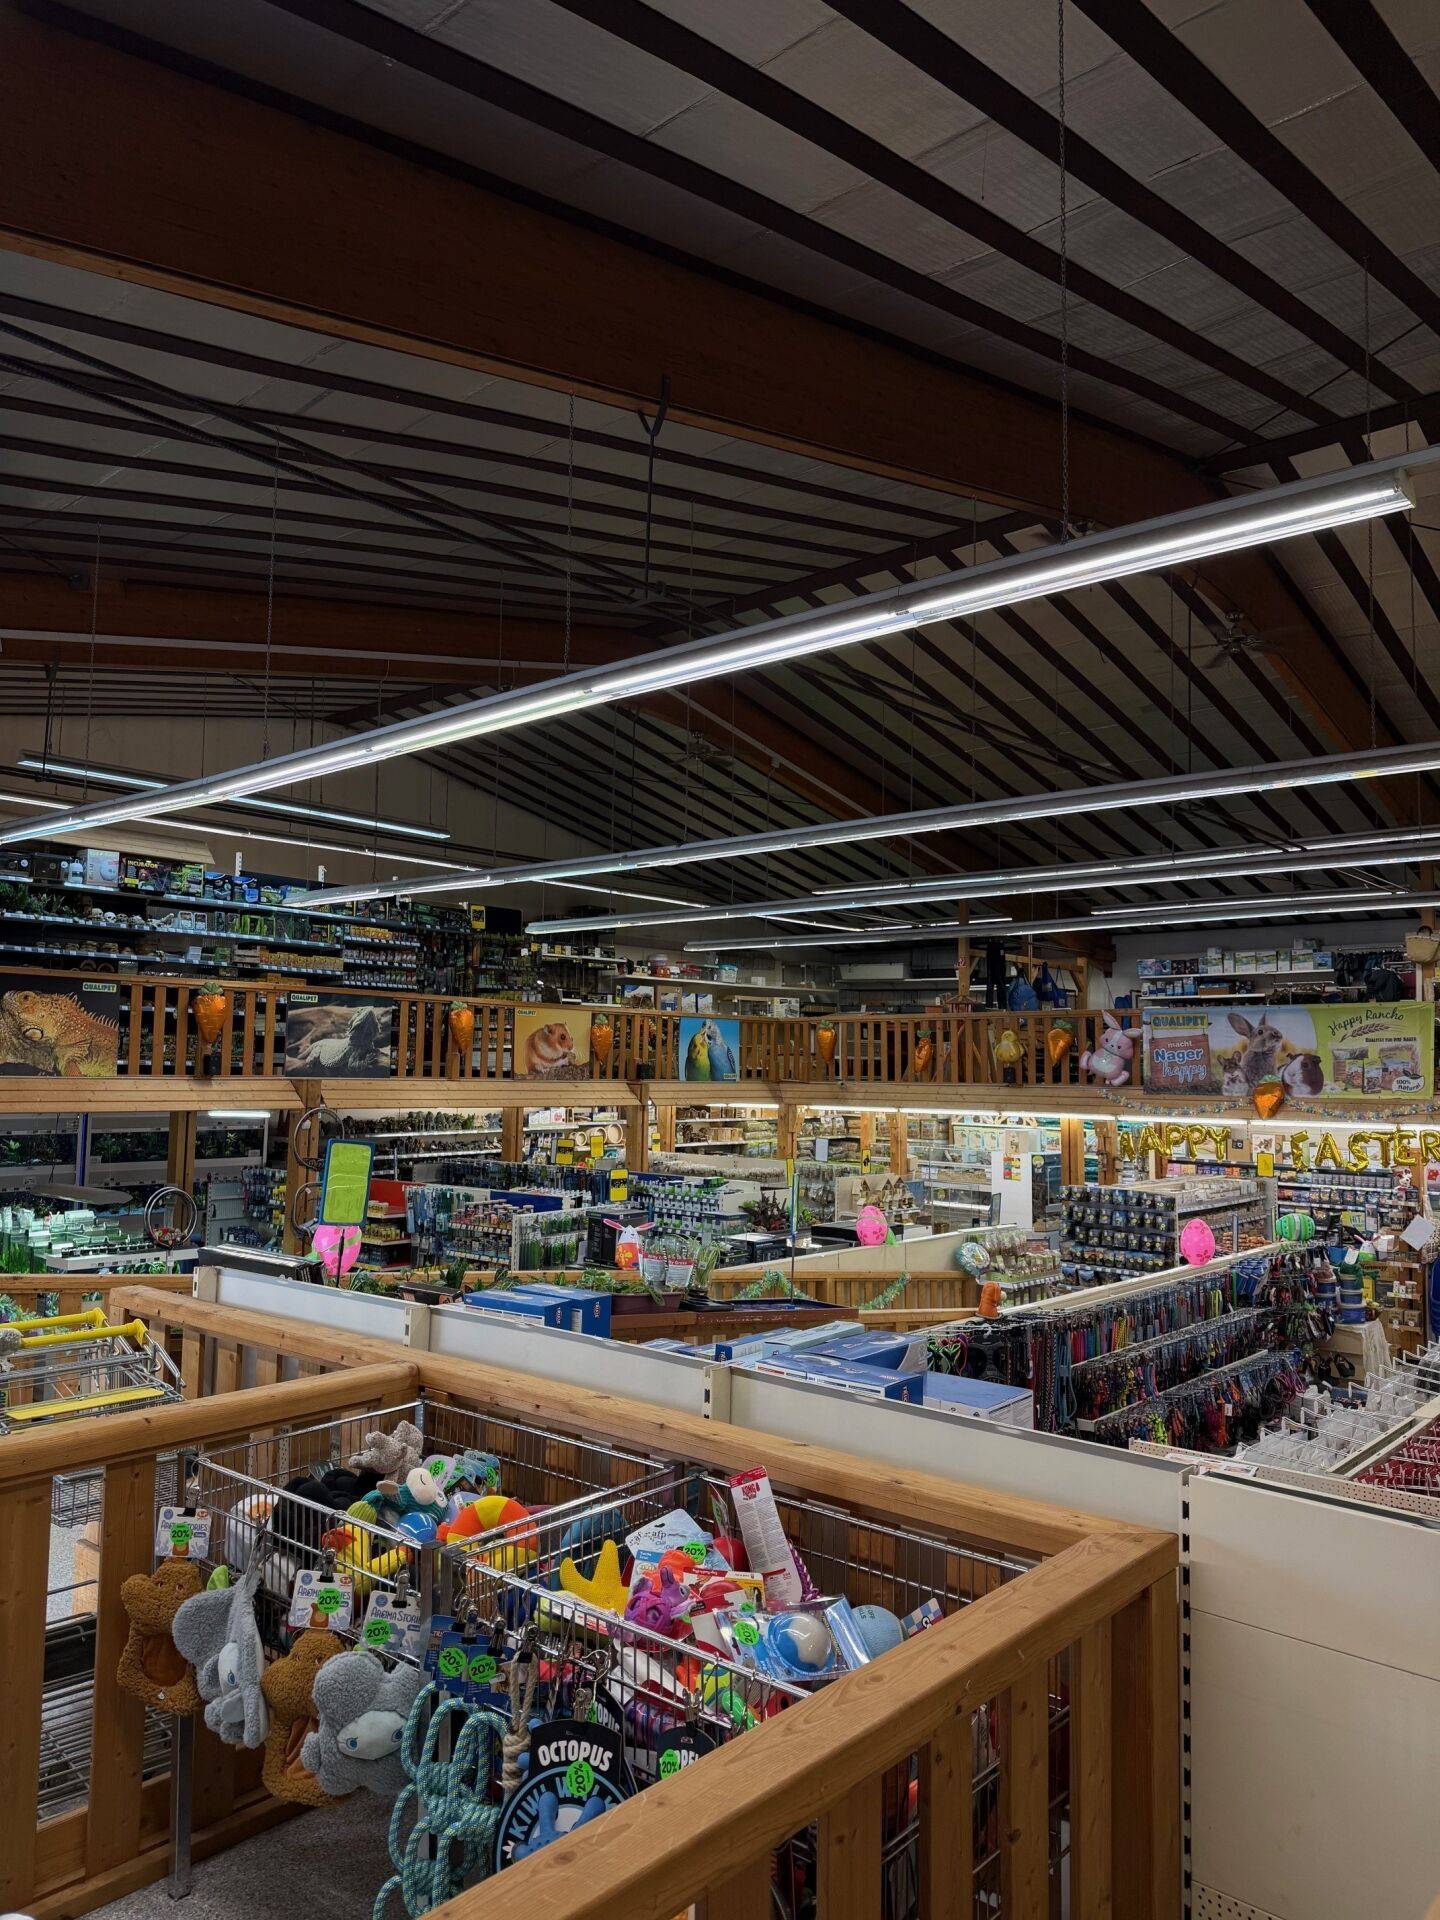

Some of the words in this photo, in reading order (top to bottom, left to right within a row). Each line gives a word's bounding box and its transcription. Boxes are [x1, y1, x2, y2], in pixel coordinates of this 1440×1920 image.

[1153, 1016, 1206, 1027] QUALIPET
[1328, 1015, 1363, 1036] Happy
[1365, 1007, 1404, 1020] Rancho
[1168, 1040, 1192, 1048] macht
[1154, 1048, 1203, 1064] Nager
[1163, 1061, 1206, 1083] happy
[171, 1530, 190, 1538] 20%
[685, 1547, 704, 1556] 20%
[319, 1596, 339, 1605] 20%
[367, 1626, 389, 1638] 20%
[743, 1624, 754, 1643] 20%
[442, 1651, 462, 1672] 20%
[471, 1662, 495, 1676] 20%
[538, 1740, 613, 1772] OCTOPUS
[662, 1761, 678, 1773] 20%
[574, 1763, 587, 1793] 20%
